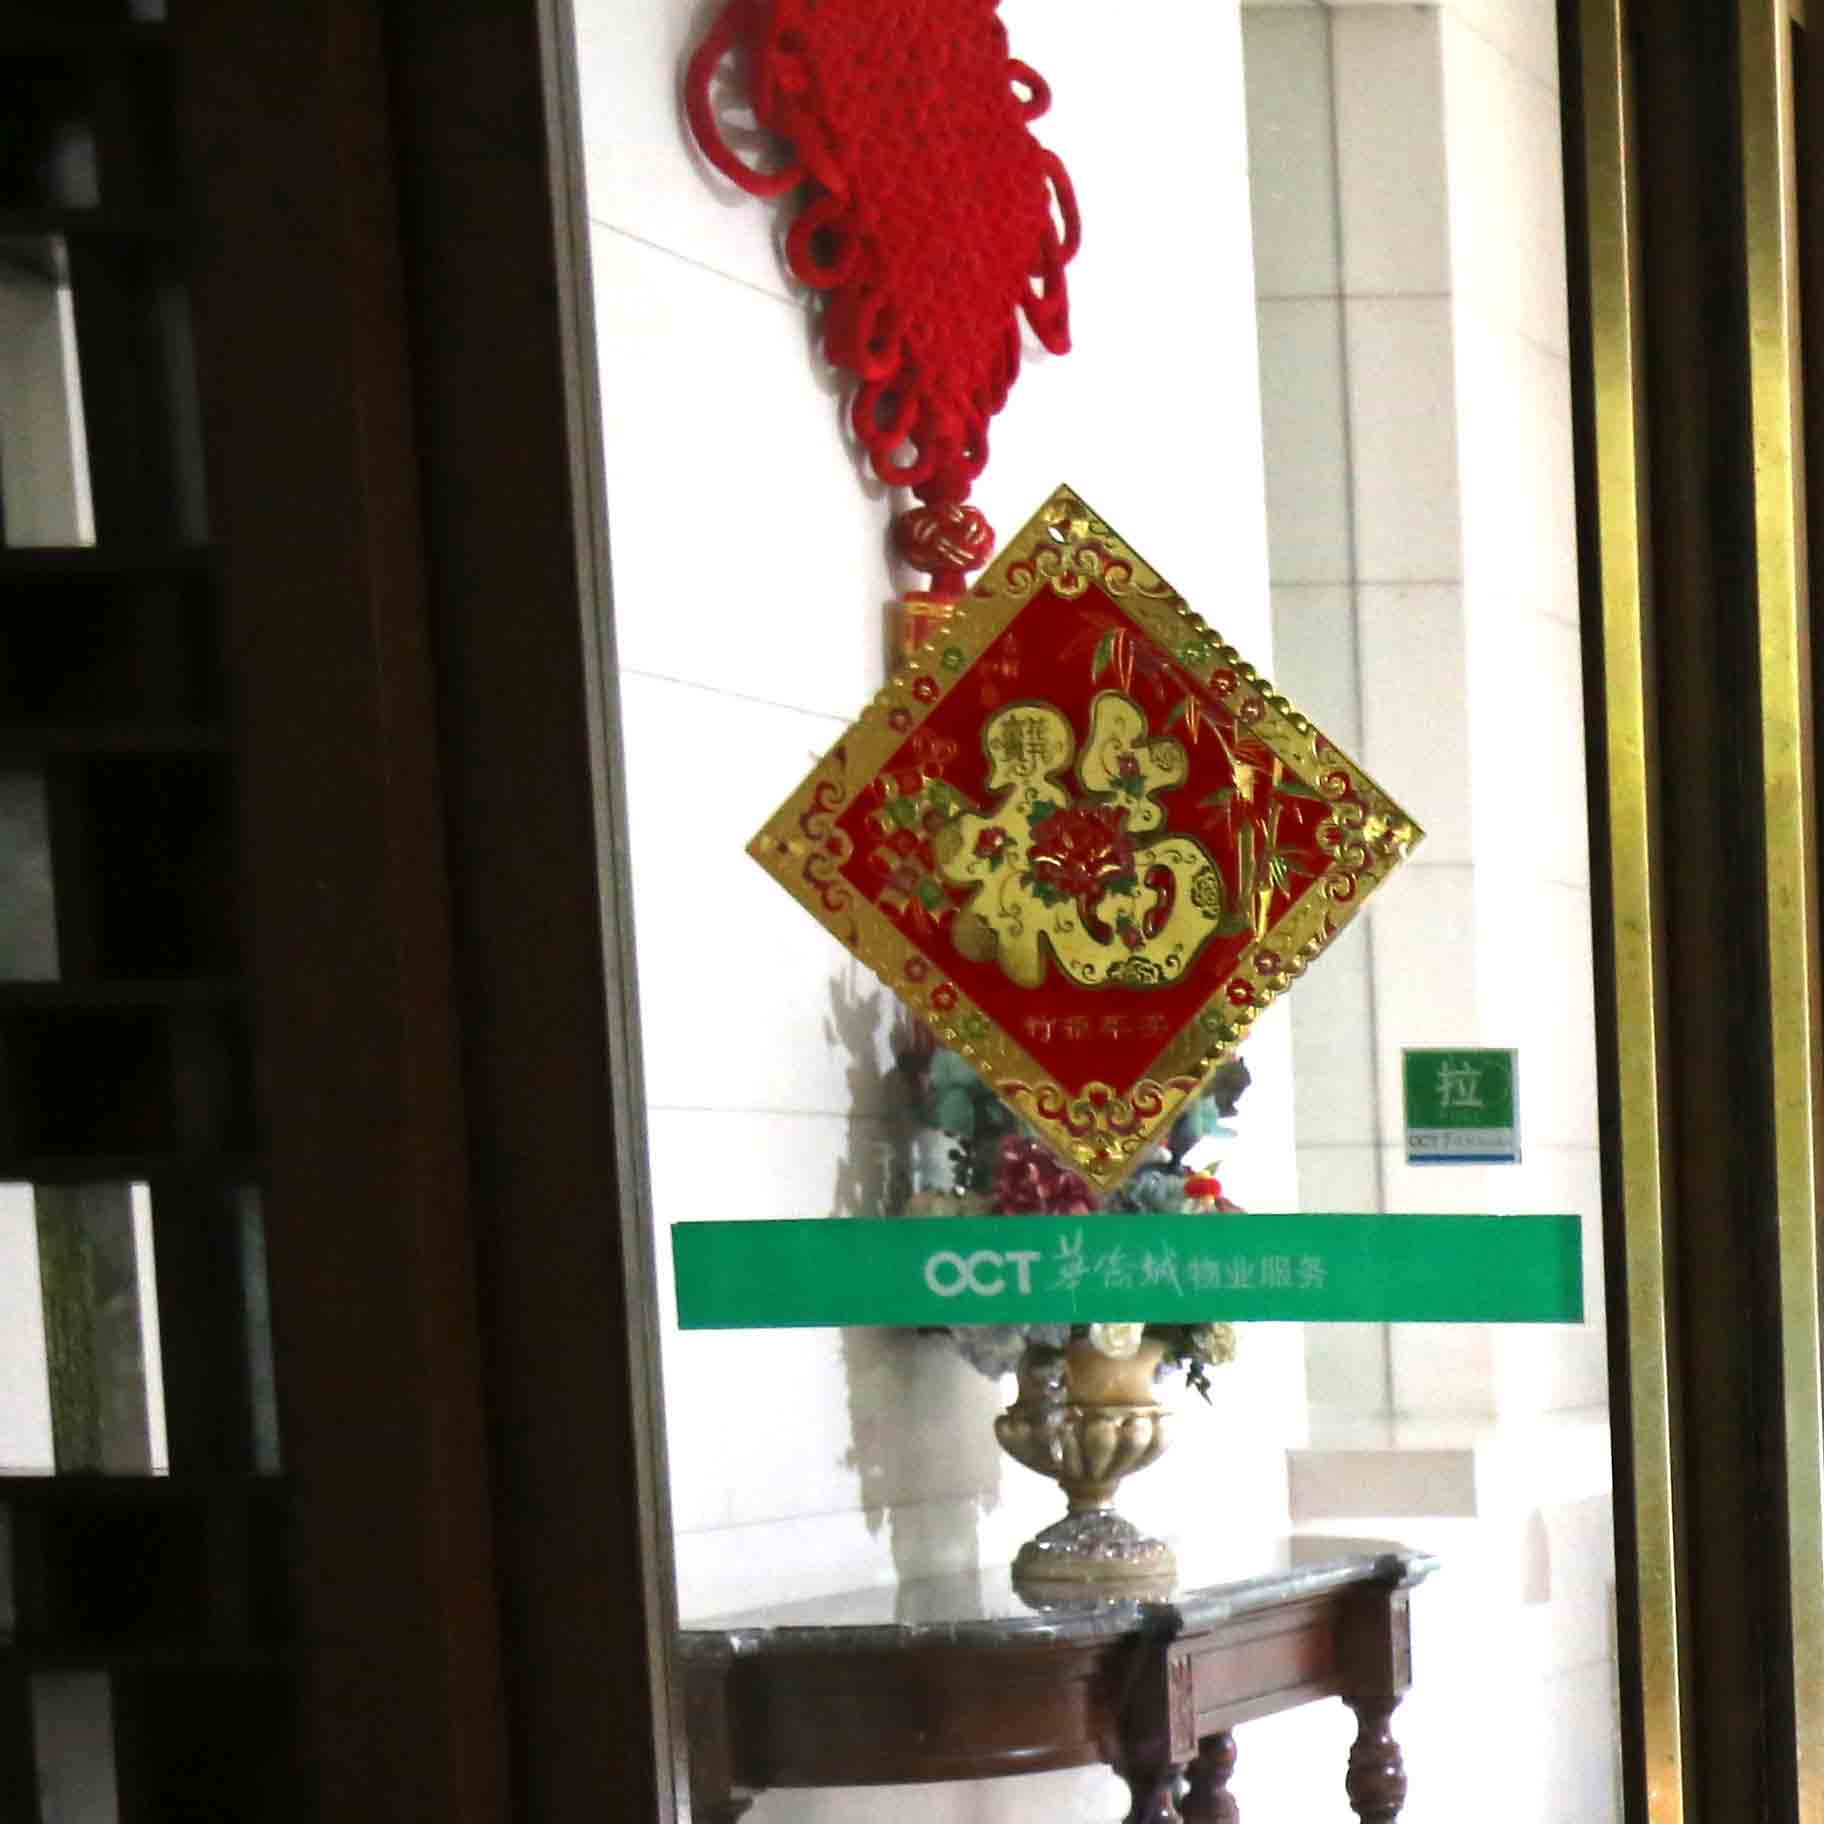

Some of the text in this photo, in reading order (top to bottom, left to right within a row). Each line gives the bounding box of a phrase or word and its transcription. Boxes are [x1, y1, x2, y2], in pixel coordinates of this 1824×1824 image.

[936, 689, 1226, 988] 福
[1435, 1060, 1484, 1108] 拉
[923, 1249, 1041, 1297] OCT
